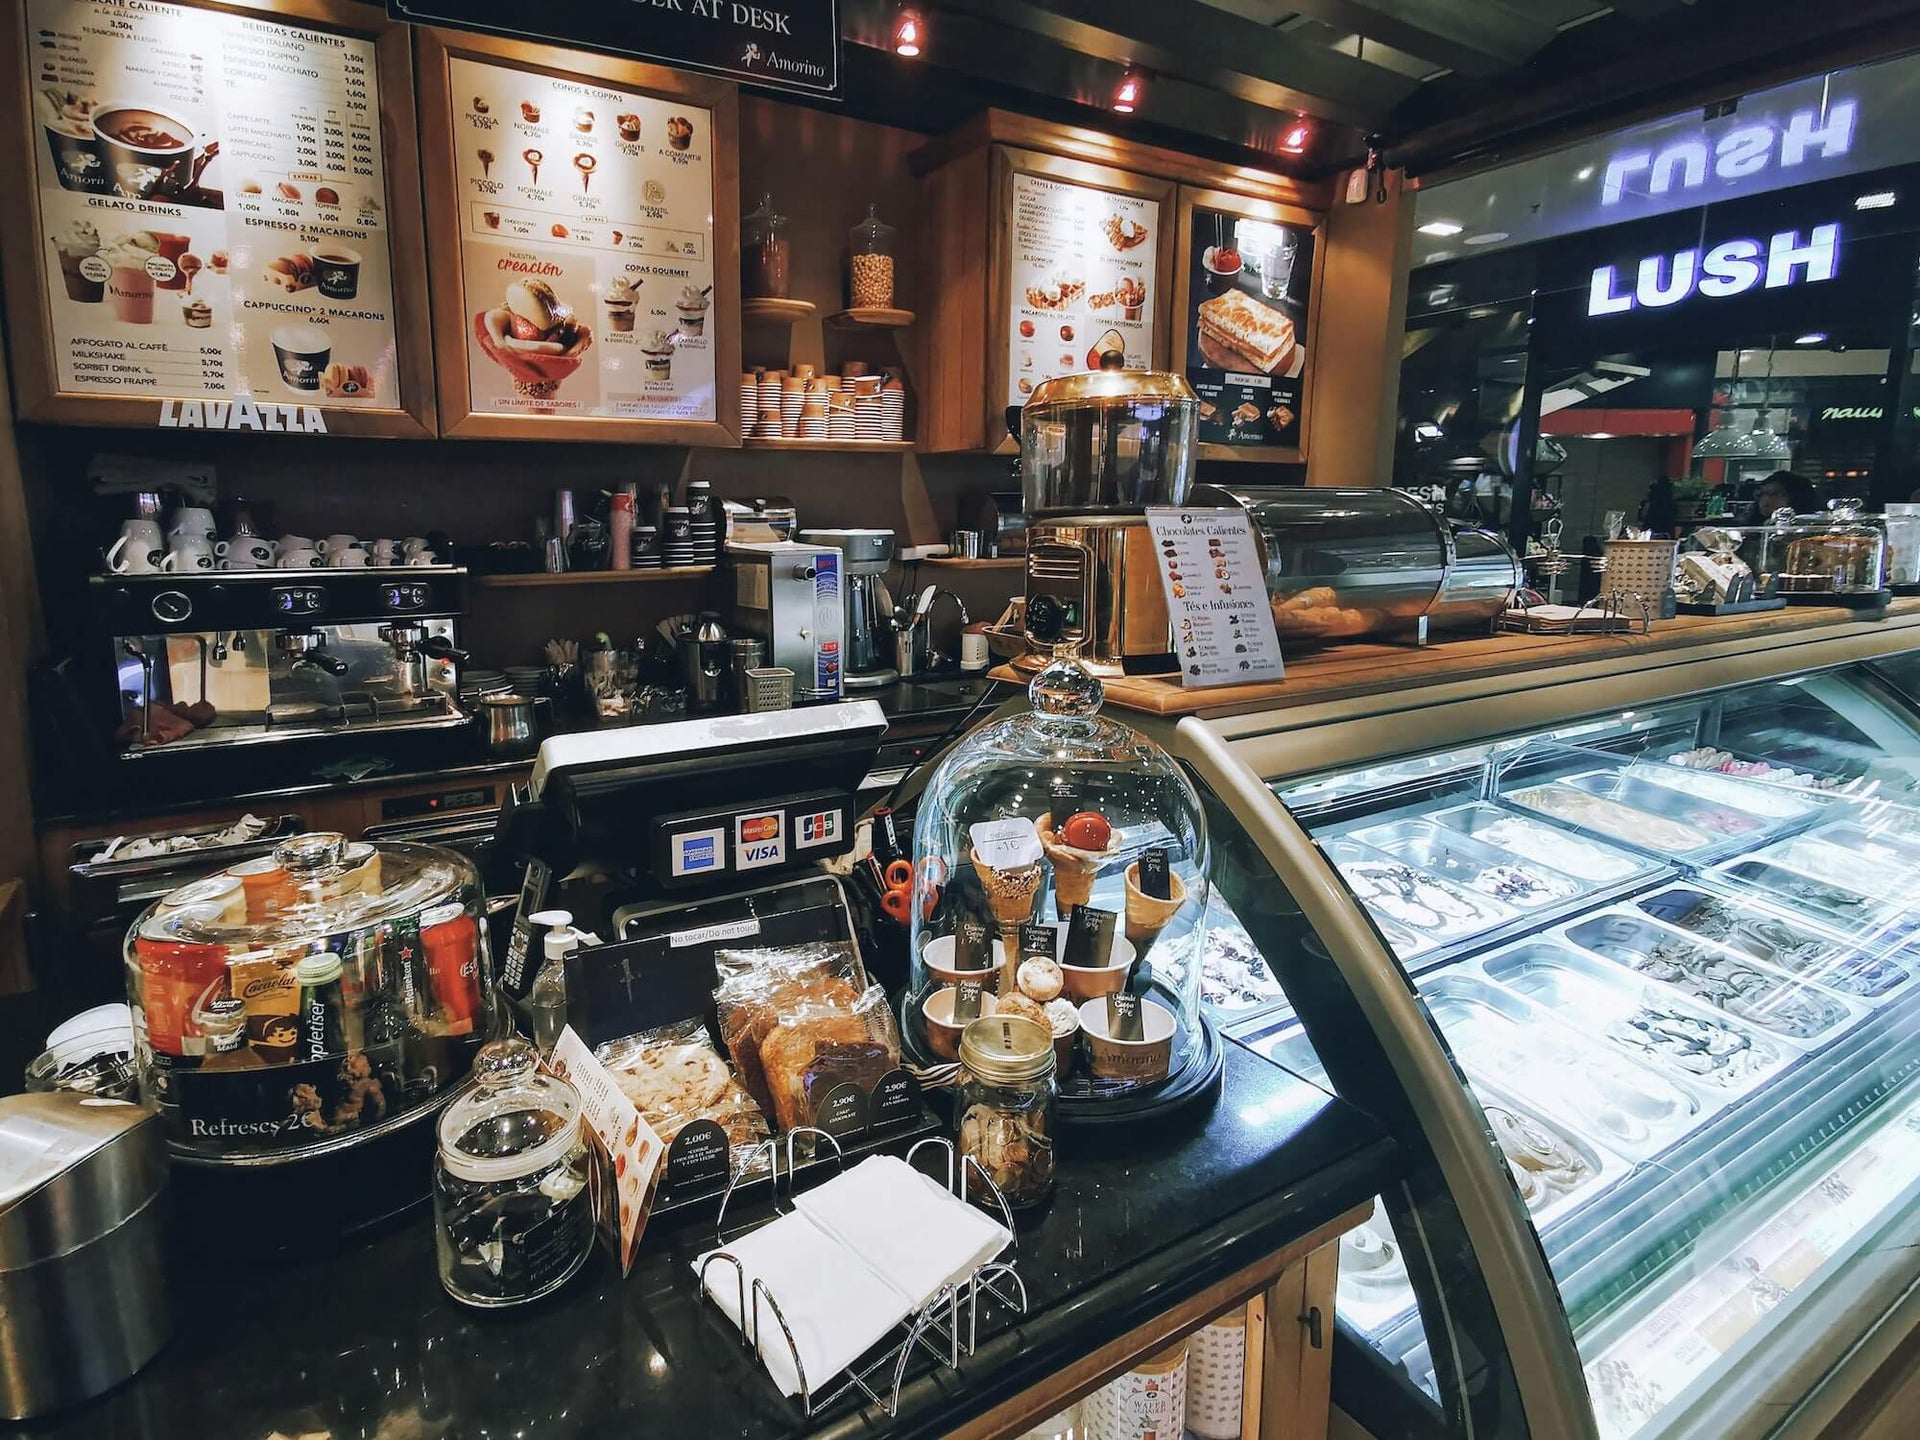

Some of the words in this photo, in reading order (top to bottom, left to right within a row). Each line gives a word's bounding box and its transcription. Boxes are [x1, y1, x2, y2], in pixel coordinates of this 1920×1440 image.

[129, 1, 183, 17] CALIENTE
[692, 0, 724, 19] AT
[733, 3, 791, 36] DESK
[242, 21, 287, 37] BEBIDAS
[290, 30, 347, 48] CALIENTES
[266, 38, 305, 52] ITALIANO
[343, 53, 365, 64] 1,50€
[766, 51, 825, 77] Amorino
[268, 62, 319, 79] MACCHIATO
[552, 81, 582, 94] CONOS
[583, 87, 590, 95] &
[592, 90, 623, 103] COPPAS
[465, 113, 499, 126] PICCOLA
[470, 178, 504, 190] PICCOLO
[517, 185, 553, 198] NORMALE
[88, 198, 136, 211] GELATO
[139, 204, 182, 216] DRINKS
[245, 217, 297, 231] ESPRESSO
[309, 225, 368, 240] MACARONS
[300, 235, 320, 243] 5,10€
[509, 251, 537, 261] NUESTRA
[497, 258, 564, 277] creación
[625, 263, 650, 275] COPAS
[652, 267, 690, 278] GOURMET
[1587, 222, 1840, 317] LUSH
[319, 307, 326, 315] 2
[329, 308, 385, 321] MACARONS
[71, 337, 123, 349] AFFOGATO
[125, 341, 137, 350] AL
[72, 350, 126, 360] MILKSHAKE
[200, 347, 222, 356] 5,00€
[73, 362, 109, 373] SORBET
[112, 365, 141, 374] DRINK
[201, 359, 223, 367] 5,70€
[75, 374, 122, 385] ESPRESSO
[203, 371, 225, 379] 5,70€
[204, 382, 226, 391] 7,00€
[534, 400, 545, 408] DE
[158, 394, 328, 434] LAVAZZA
[1156, 525, 1205, 536] Chocolates
[1206, 524, 1246, 535] Calientes
[1183, 602, 1200, 612] Tés
[1210, 600, 1255, 611] Infusiones
[742, 822, 778, 837] MasterCard
[745, 845, 779, 862] VISA
[671, 935, 684, 944] No
[720, 928, 736, 936] not
[684, 1131, 712, 1145] 2,00€
